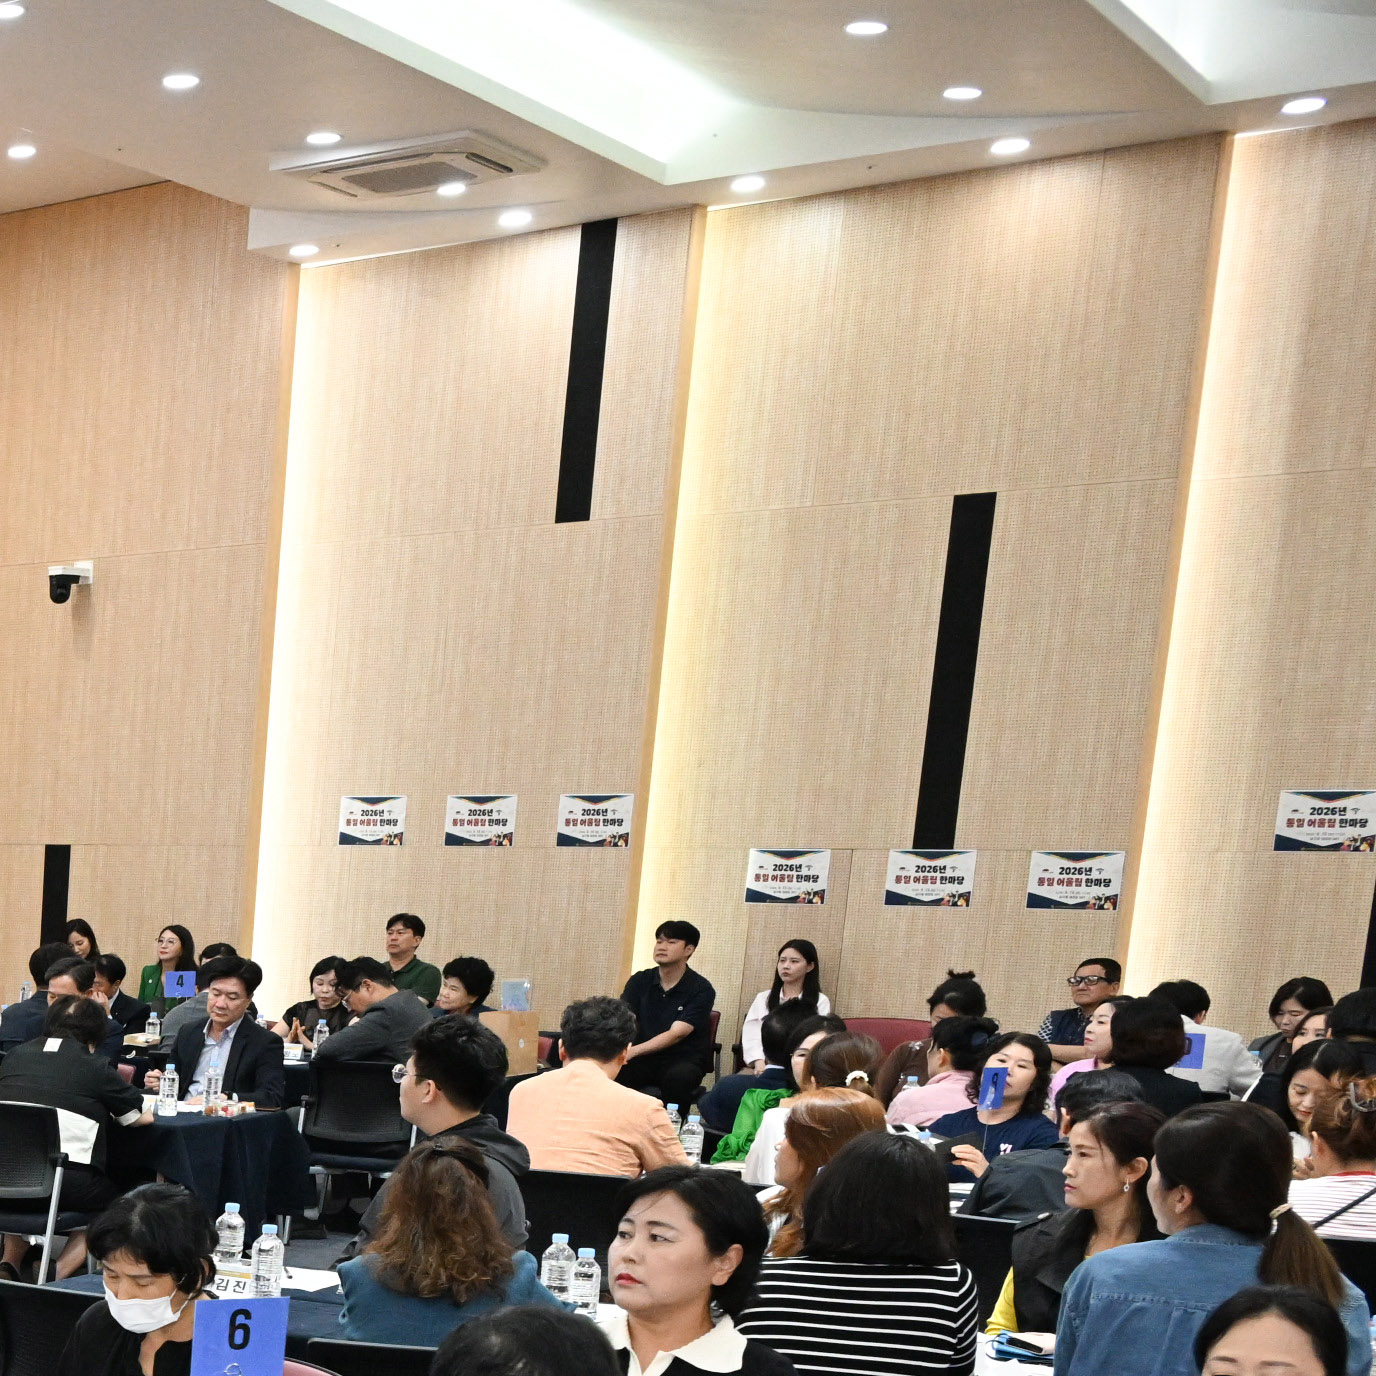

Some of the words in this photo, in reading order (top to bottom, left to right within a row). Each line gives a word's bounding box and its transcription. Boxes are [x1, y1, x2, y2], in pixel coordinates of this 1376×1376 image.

[360, 809, 385, 818] 2026년
[468, 808, 494, 817] 2026년
[581, 808, 608, 816] 2026년
[1309, 806, 1347, 816] 2026년
[772, 864, 802, 872] 2026년
[914, 864, 947, 874] 2026년
[1058, 866, 1093, 876] 2026년
[176, 974, 185, 988] 4
[228, 1308, 253, 1351] 6
